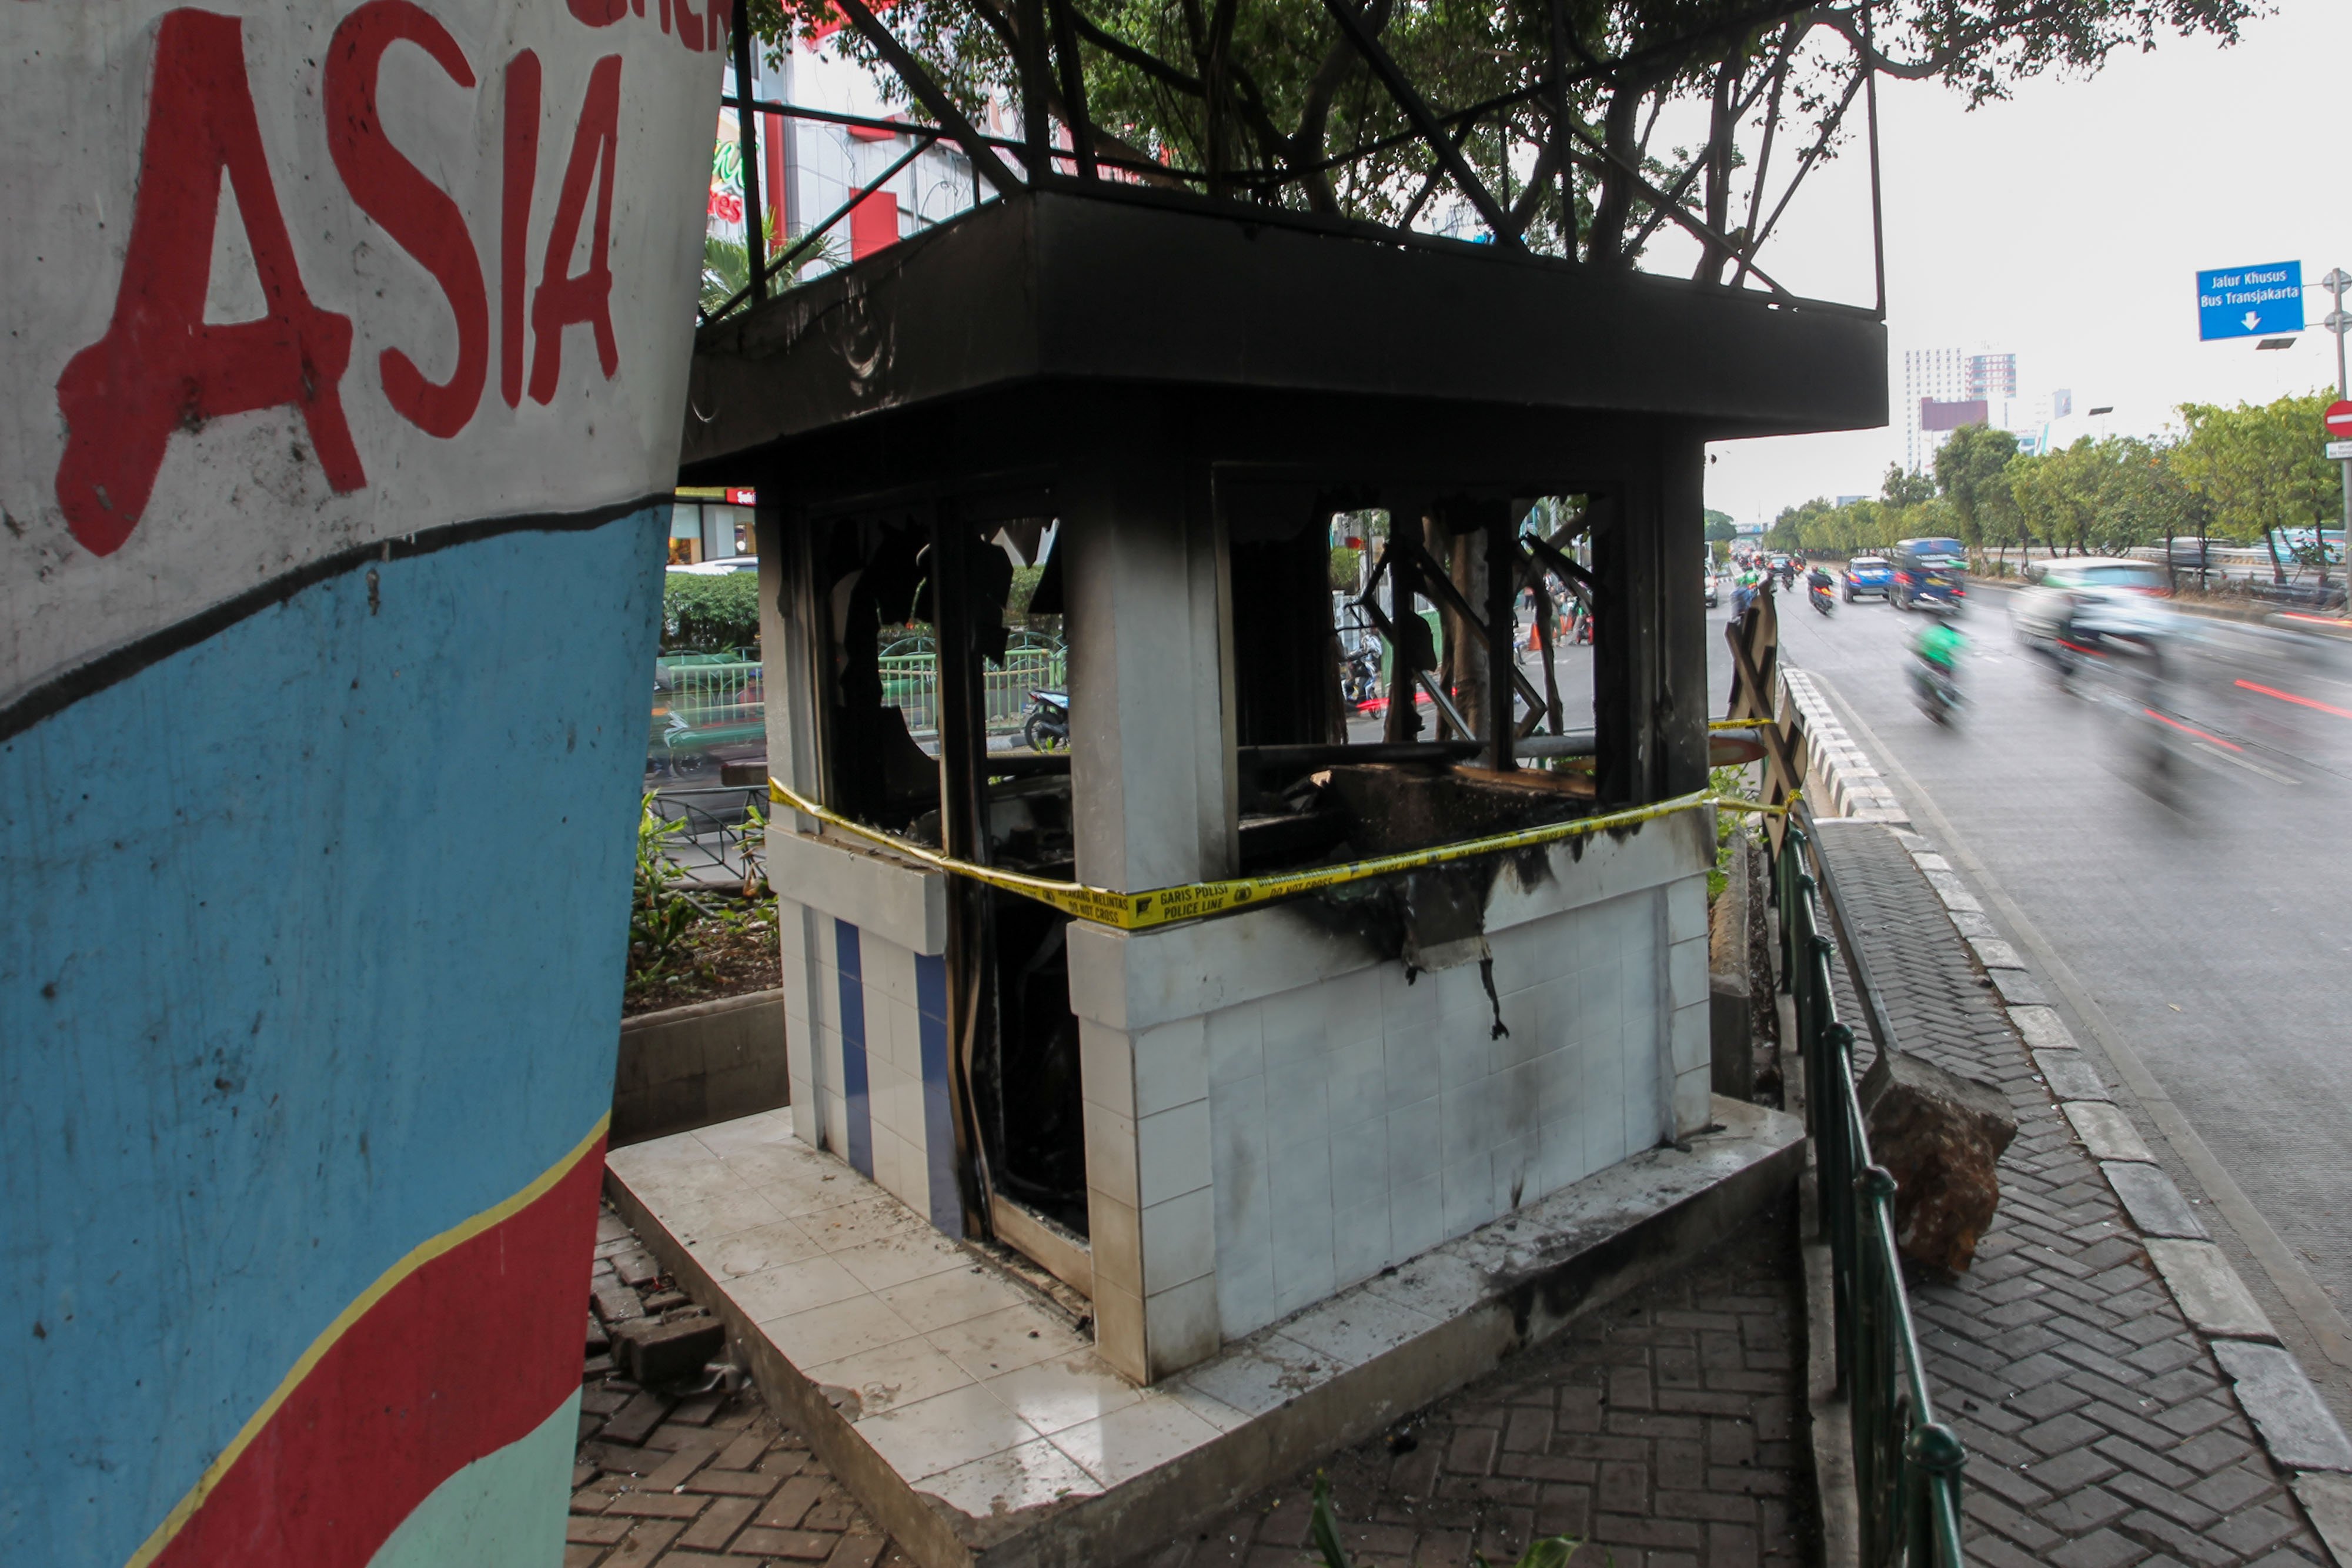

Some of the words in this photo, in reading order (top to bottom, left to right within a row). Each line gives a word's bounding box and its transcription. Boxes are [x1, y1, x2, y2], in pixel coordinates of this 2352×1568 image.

[55, 0, 622, 557] ASIA
[2211, 275, 2241, 289] Jalur
[2244, 270, 2287, 285] Khusus
[2200, 294, 2223, 307] Bus
[2225, 286, 2300, 305] Transjakarta
[1092, 892, 1128, 911] MELINTAS
[1160, 888, 1192, 905] GARIS
[1194, 883, 1228, 900] POLISI
[1068, 900, 1079, 913] DO
[1080, 904, 1093, 917] NOT
[1095, 906, 1119, 924] CROSS
[1164, 901, 1198, 920] POLICE
[1202, 897, 1224, 912] LINE
